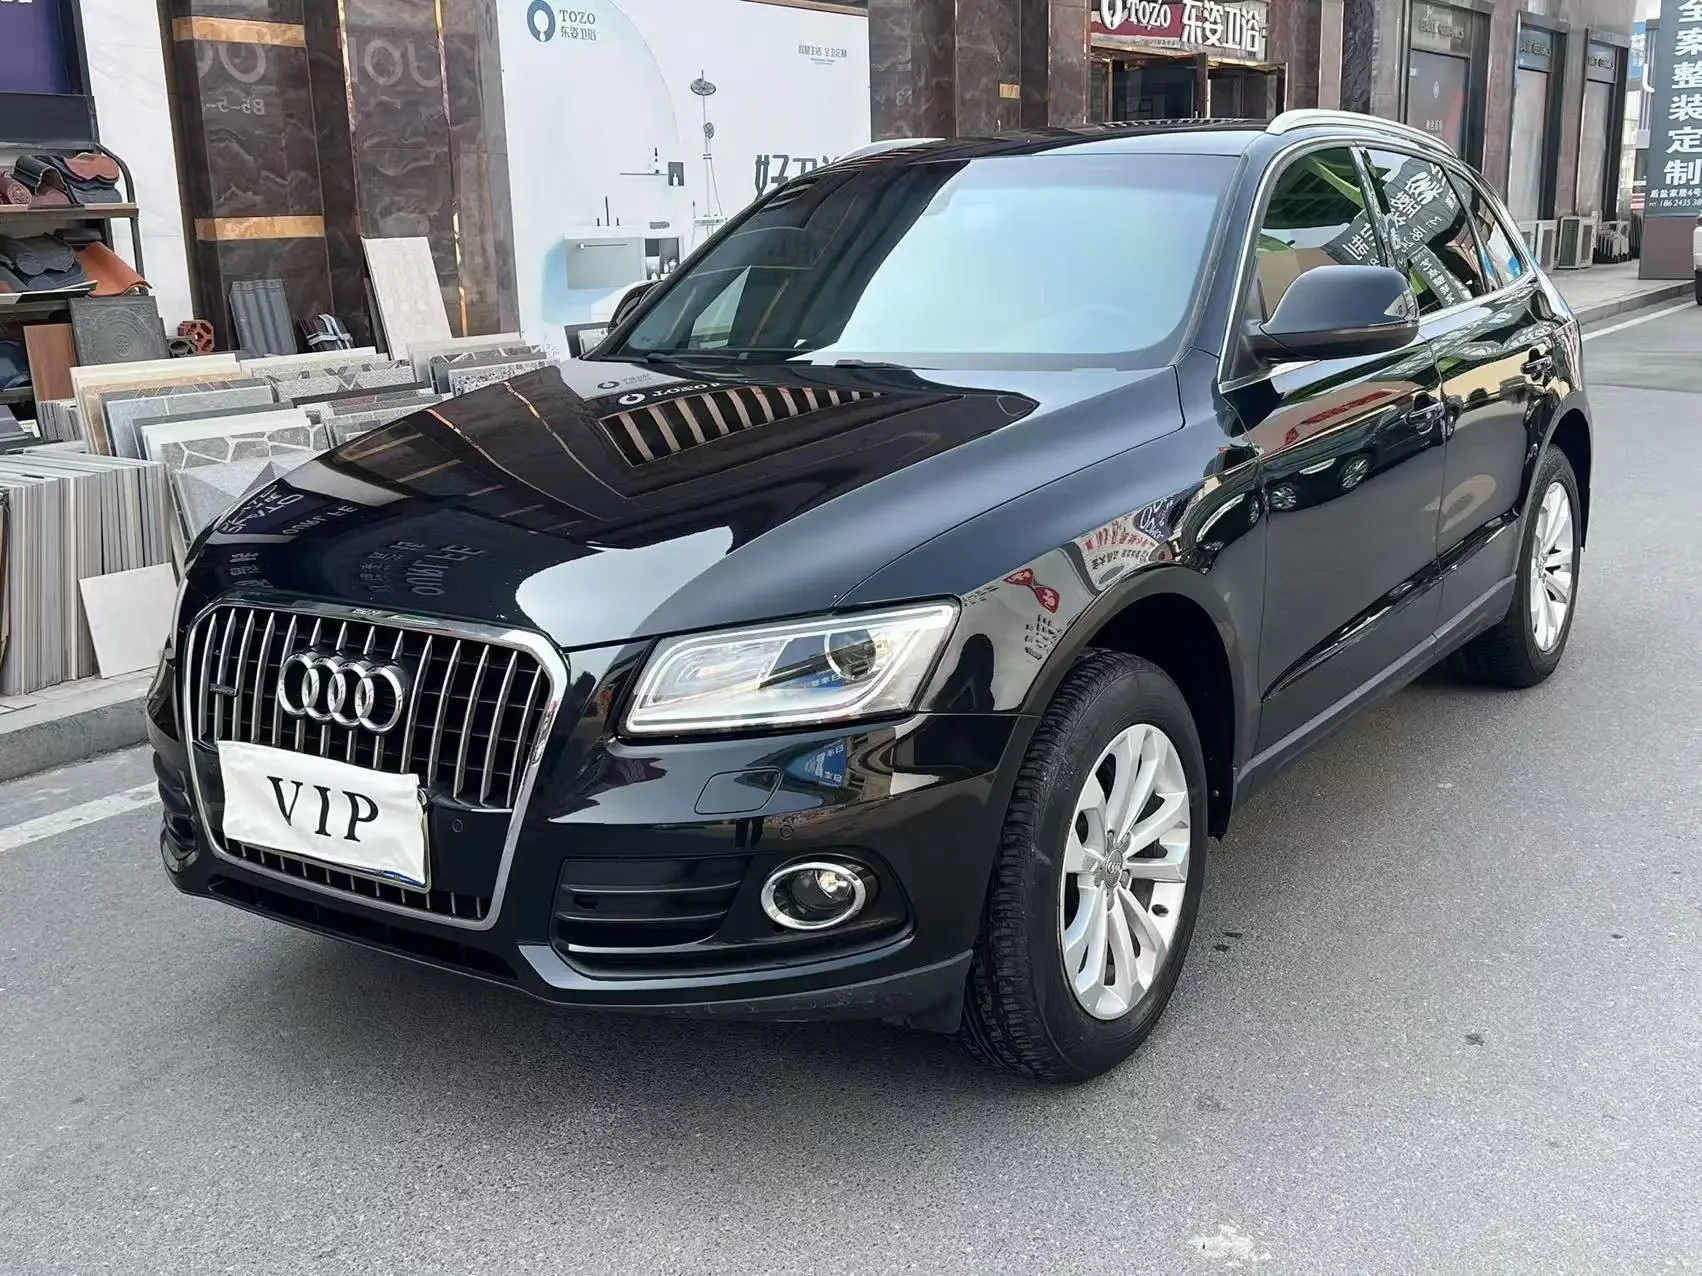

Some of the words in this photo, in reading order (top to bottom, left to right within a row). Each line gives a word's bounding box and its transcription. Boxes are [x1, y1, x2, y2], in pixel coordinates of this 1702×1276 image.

[559, 9, 596, 25] TOZO
[1127, 0, 1171, 30] TOZO
[1181, 0, 1260, 52] 东姿卫浴
[267, 775, 379, 842] VIP
